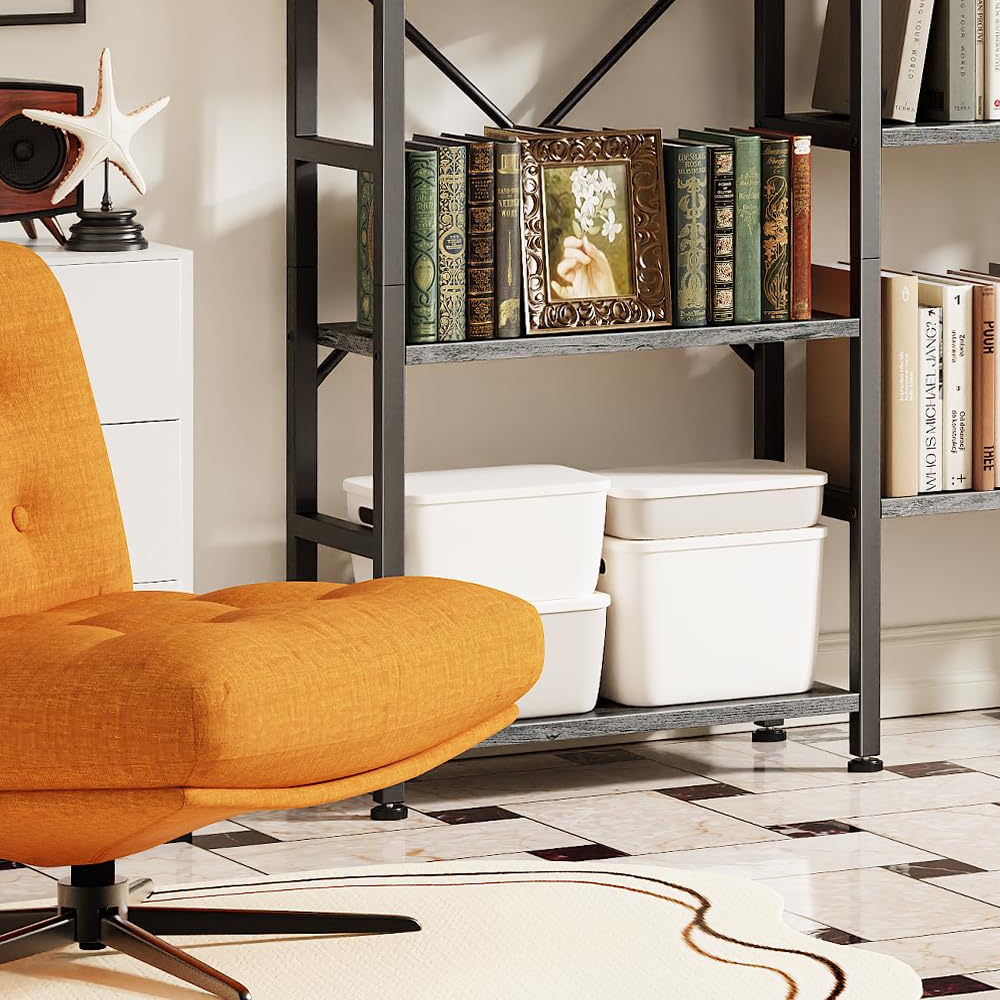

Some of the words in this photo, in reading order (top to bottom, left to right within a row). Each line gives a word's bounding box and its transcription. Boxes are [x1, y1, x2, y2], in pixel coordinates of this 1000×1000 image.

[914, 17, 922, 42] YOUR
[908, 49, 917, 79] WORLD
[954, 294, 960, 305] 1
[926, 321, 937, 366] JANG?
[926, 370, 936, 434] MICHAEL
[926, 436, 936, 450] IS
[926, 452, 936, 490] WHO
